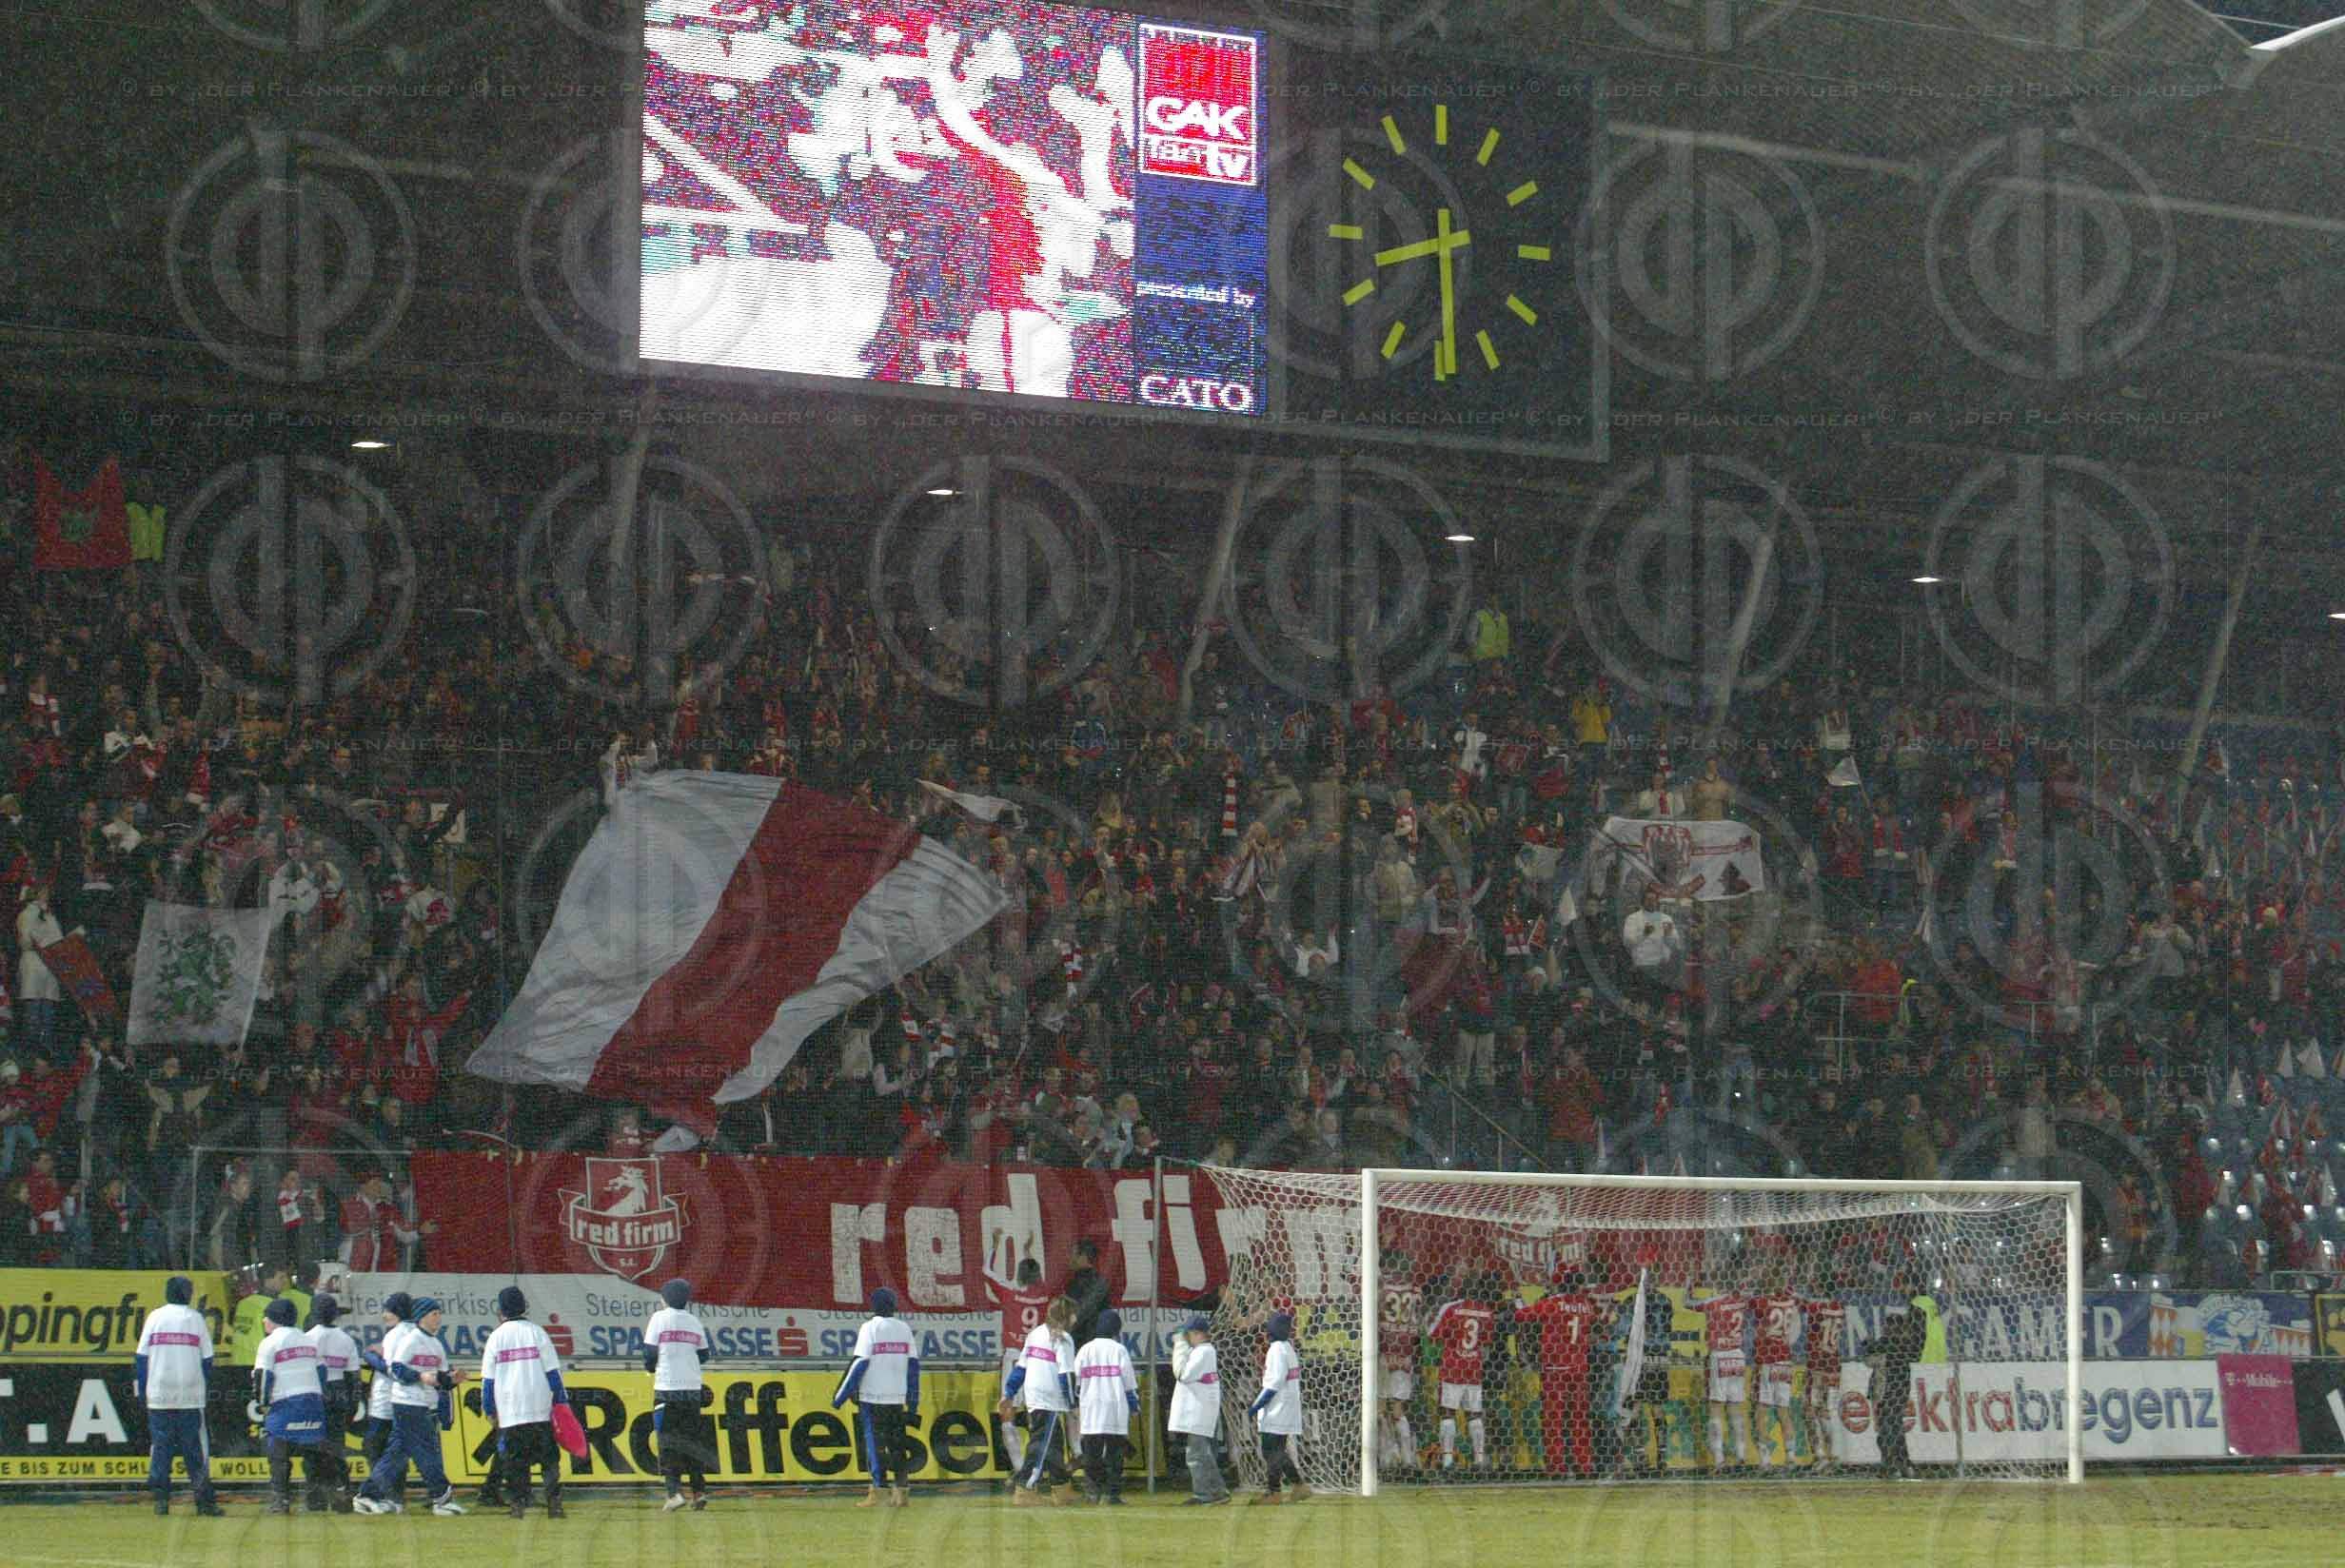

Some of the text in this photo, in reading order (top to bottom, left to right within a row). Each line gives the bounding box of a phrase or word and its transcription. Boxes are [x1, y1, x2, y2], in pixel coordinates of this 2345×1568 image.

[1146, 95, 1251, 141] GAK
[1140, 375, 1253, 411] CATO
[577, 1218, 675, 1246] red firm
[831, 1173, 1044, 1304] red
[589, 1325, 773, 1357] SPAASSE
[820, 1330, 996, 1358] SPASSE
[1462, 1318, 1479, 1349] 3
[20, 1461, 49, 1475] BIS
[57, 1461, 95, 1475] ZUM
